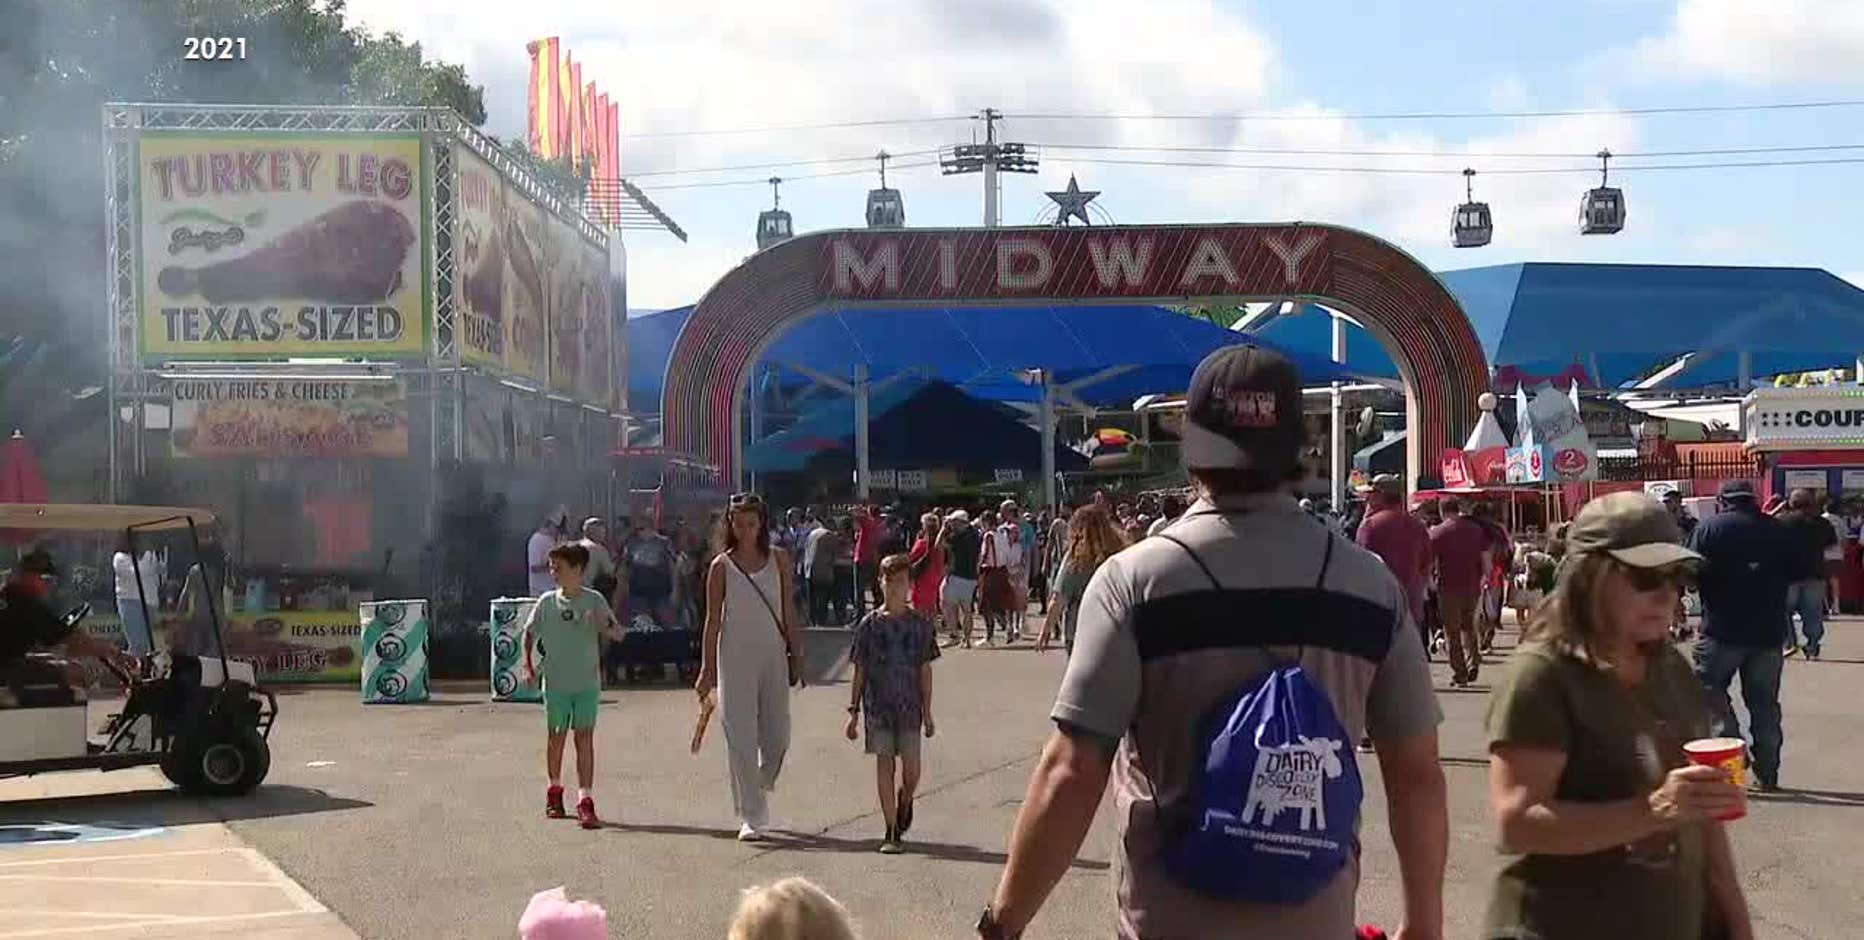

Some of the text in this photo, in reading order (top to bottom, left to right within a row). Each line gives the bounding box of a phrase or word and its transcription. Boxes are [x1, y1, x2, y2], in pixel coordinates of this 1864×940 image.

[151, 150, 321, 201] TURKEY
[337, 152, 412, 201] LEG
[832, 234, 1320, 292] MIDWAY
[160, 305, 405, 343] TEXAS-SIZED
[174, 382, 222, 400] CURLY
[228, 382, 269, 400] FRIES
[274, 382, 290, 399] &
[291, 382, 350, 400] CHEESE
